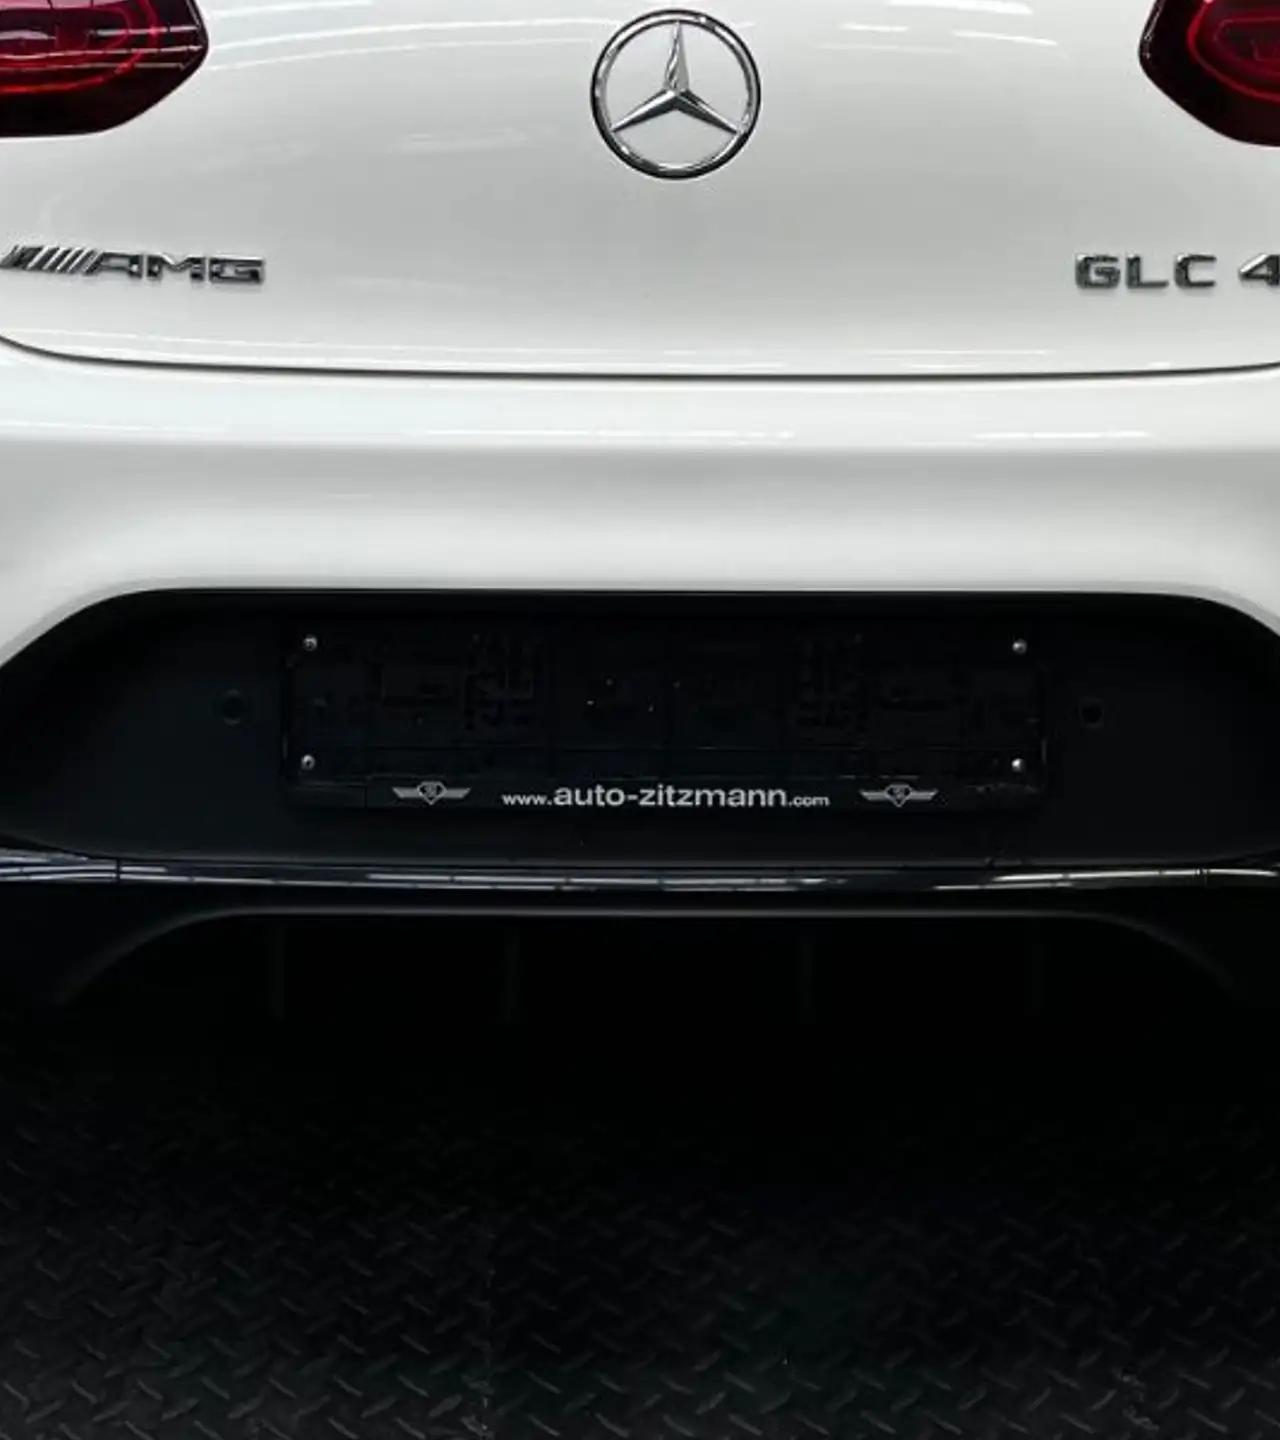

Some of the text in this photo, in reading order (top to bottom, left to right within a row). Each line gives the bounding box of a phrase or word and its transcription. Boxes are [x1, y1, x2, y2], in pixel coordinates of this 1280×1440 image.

[80, 248, 265, 283] AMG
[1075, 253, 1218, 289] GLC
[501, 783, 830, 806] www.auto-zitzmann.com
